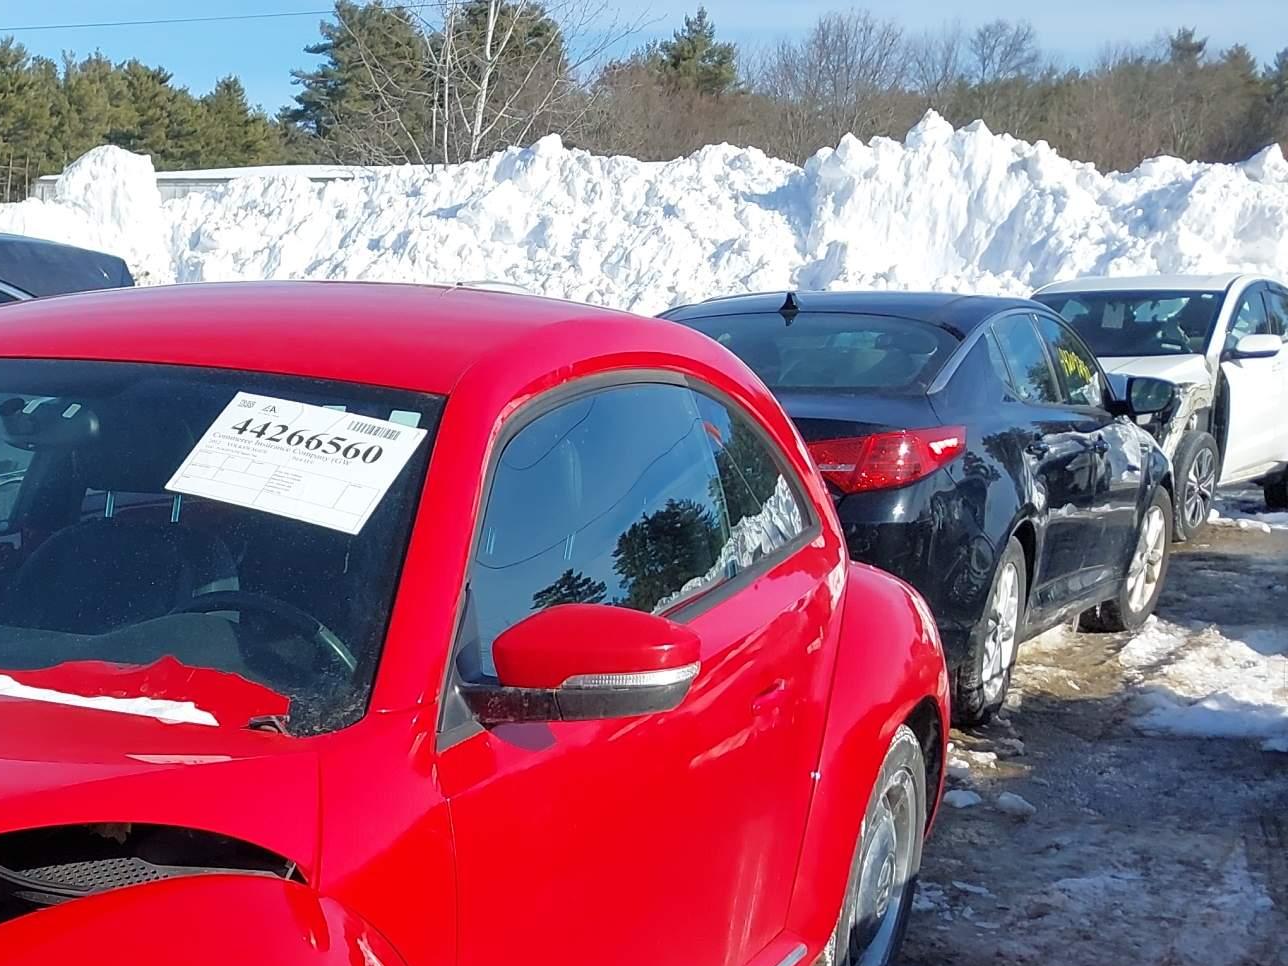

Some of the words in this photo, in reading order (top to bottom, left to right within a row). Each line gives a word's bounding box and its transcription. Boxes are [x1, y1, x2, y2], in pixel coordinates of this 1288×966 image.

[212, 431, 252, 444] Commerce
[254, 439, 291, 452] Insurance
[292, 448, 327, 461] Company
[231, 417, 383, 463] 44266560
